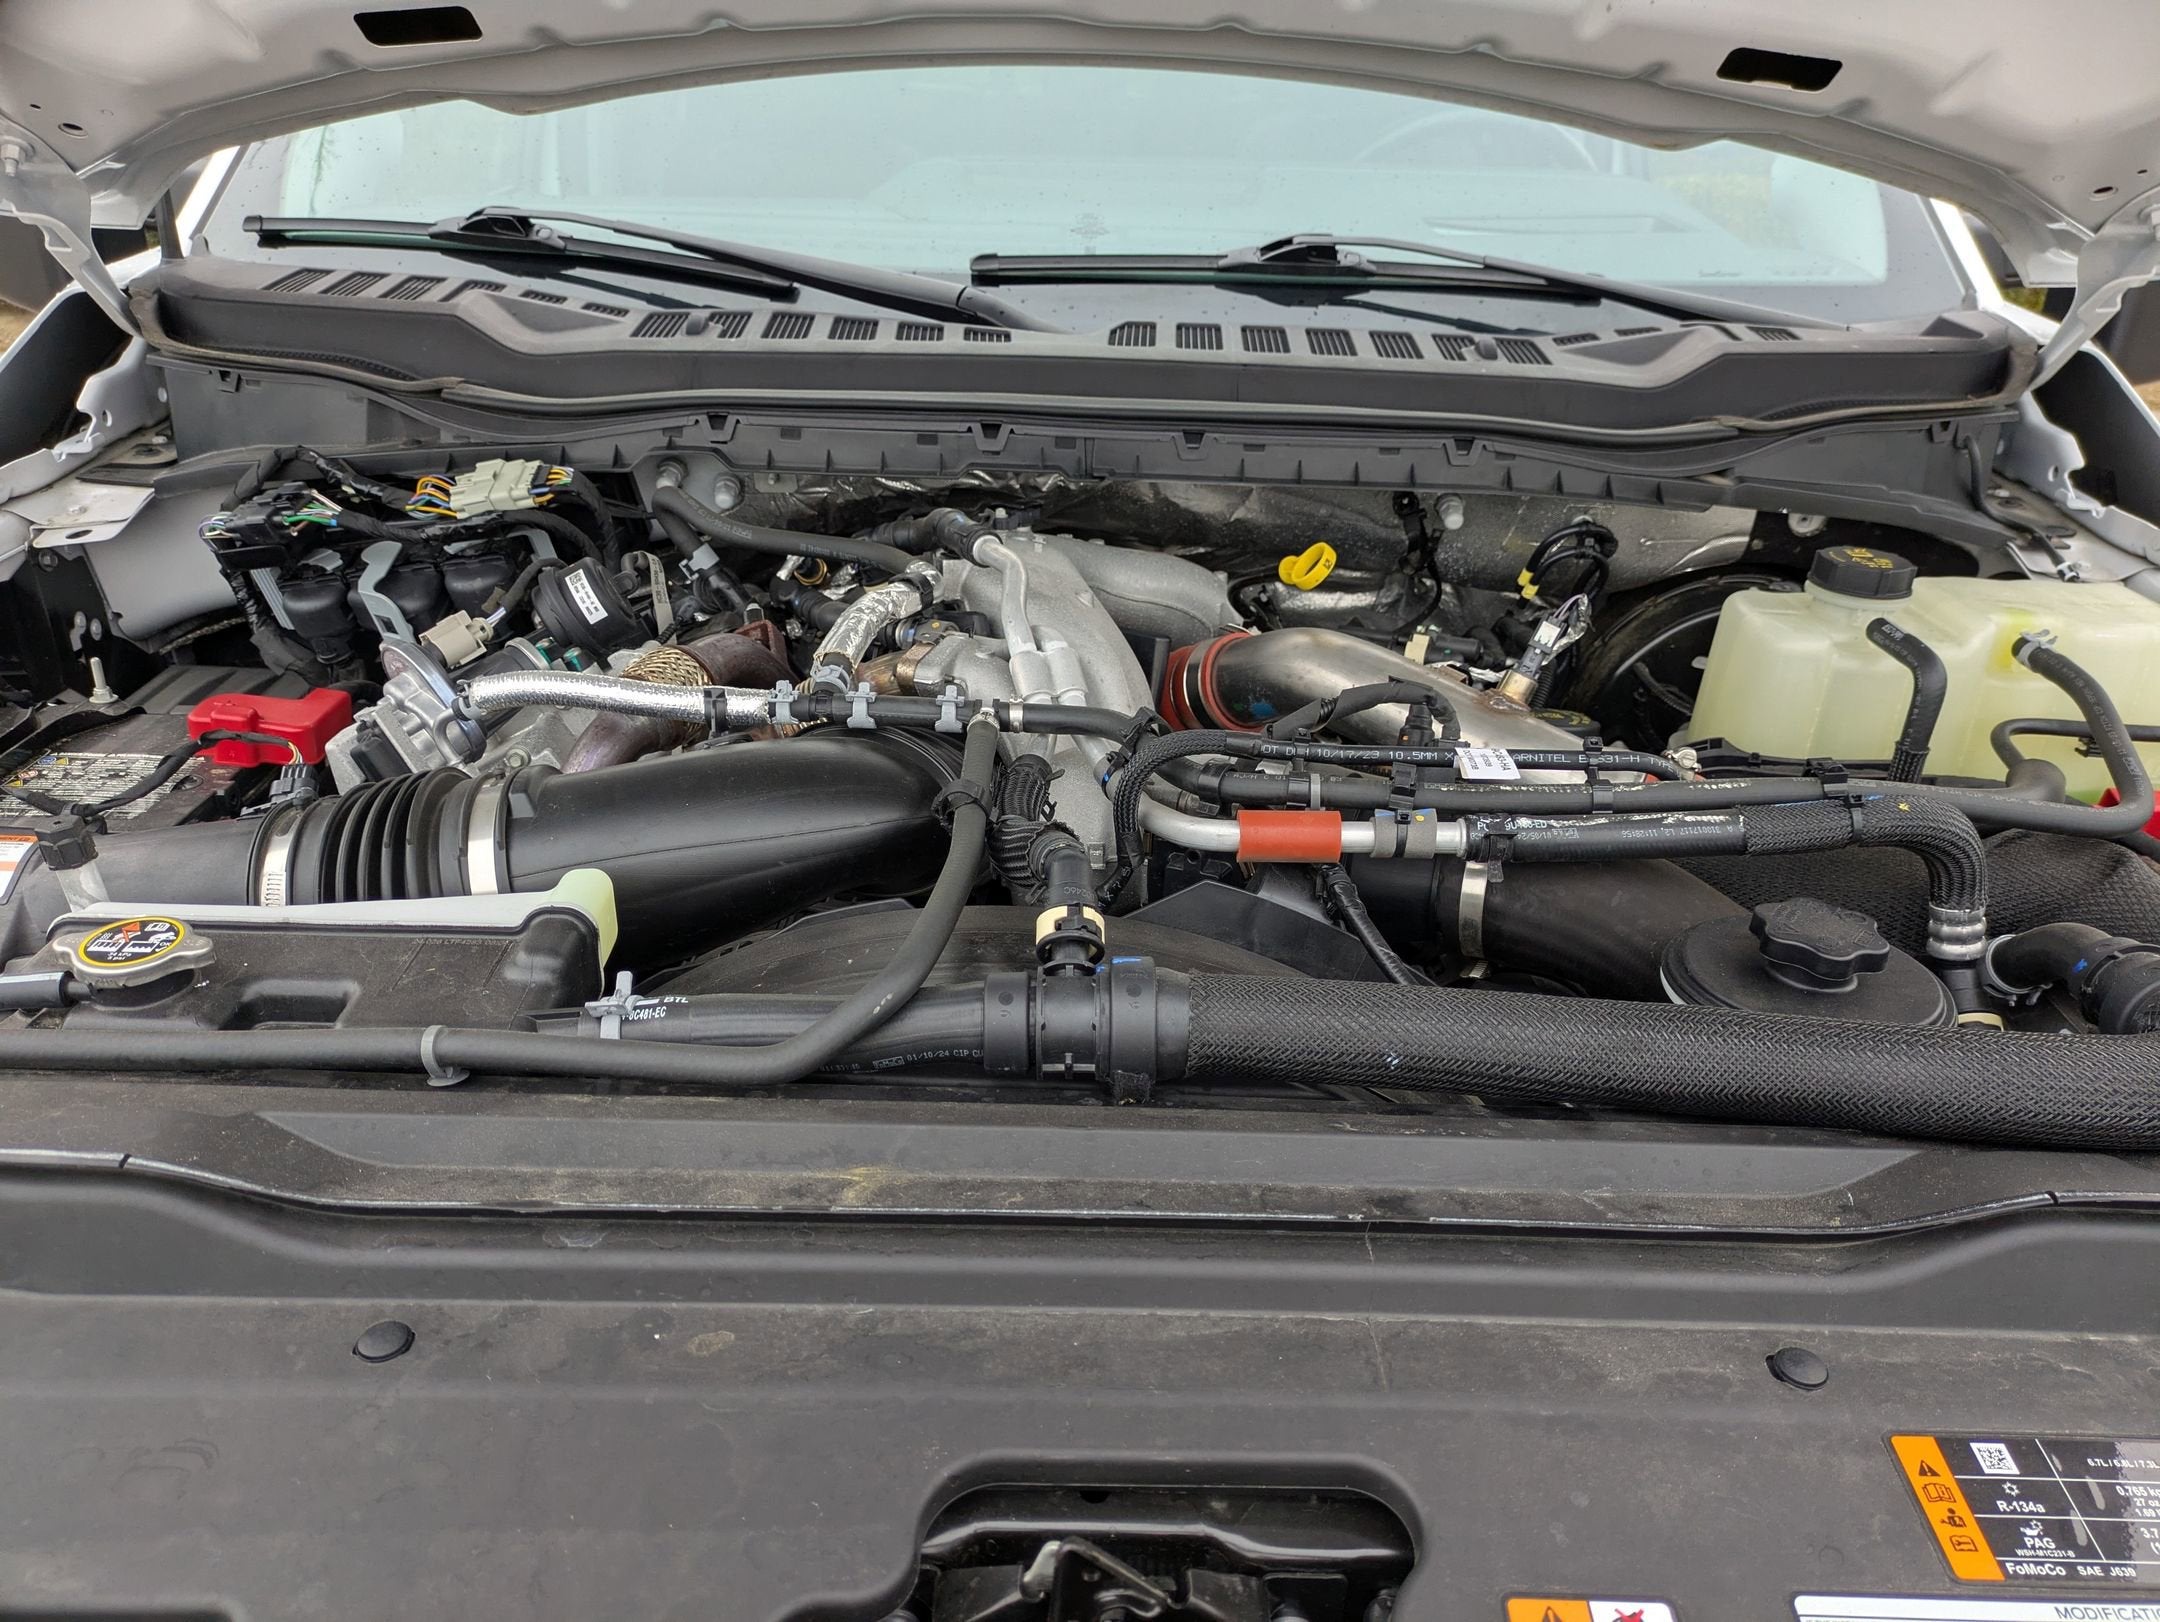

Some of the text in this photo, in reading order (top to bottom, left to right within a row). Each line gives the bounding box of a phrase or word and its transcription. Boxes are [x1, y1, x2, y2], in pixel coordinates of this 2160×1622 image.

[1260, 745, 1279, 755] OT
[1317, 749, 1379, 760] 10/17/23
[1388, 751, 1438, 761] 10.5MM
[1512, 753, 1571, 763] ARNITEL
[906, 1050, 950, 1062] 01/10/24
[2115, 1485, 2148, 1498] 0.765
[1996, 1500, 2046, 1514] R-134a
[2133, 1498, 2146, 1507] 27
[2140, 1527, 2159, 1539] 3.7
[2024, 1537, 2056, 1549] PAG
[2005, 1562, 2136, 1578] FoMoCo SAE J639
